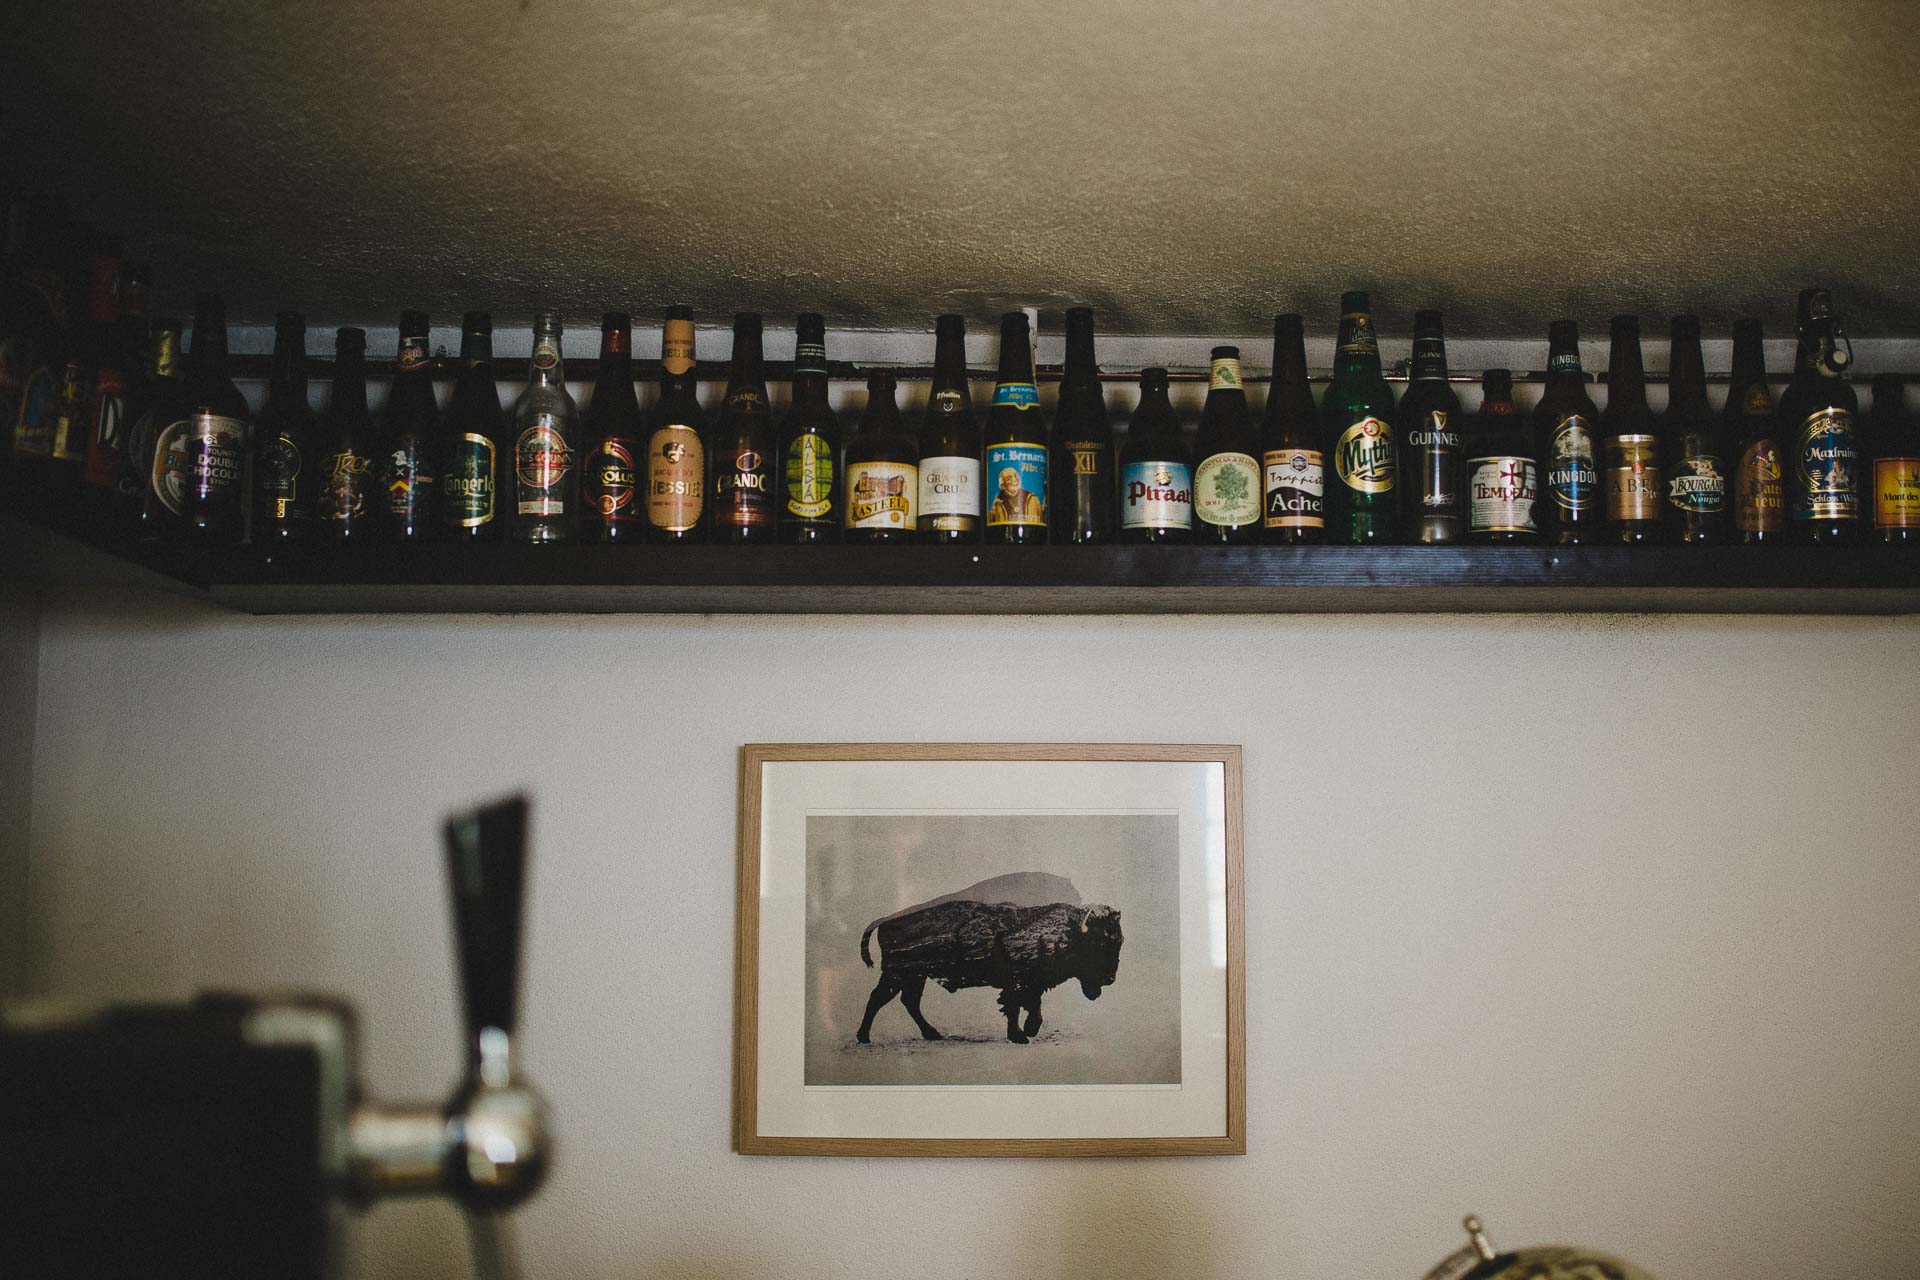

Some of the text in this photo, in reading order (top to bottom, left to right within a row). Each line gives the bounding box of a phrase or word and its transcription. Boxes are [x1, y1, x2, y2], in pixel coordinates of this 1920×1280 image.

[1551, 354, 1579, 366] KINGDO
[1409, 430, 1459, 446] GUINNES
[1073, 452, 1097, 474] XII
[934, 484, 959, 494] CRU
[1271, 493, 1323, 513] Achel
[1883, 492, 1919, 501] Mont des
